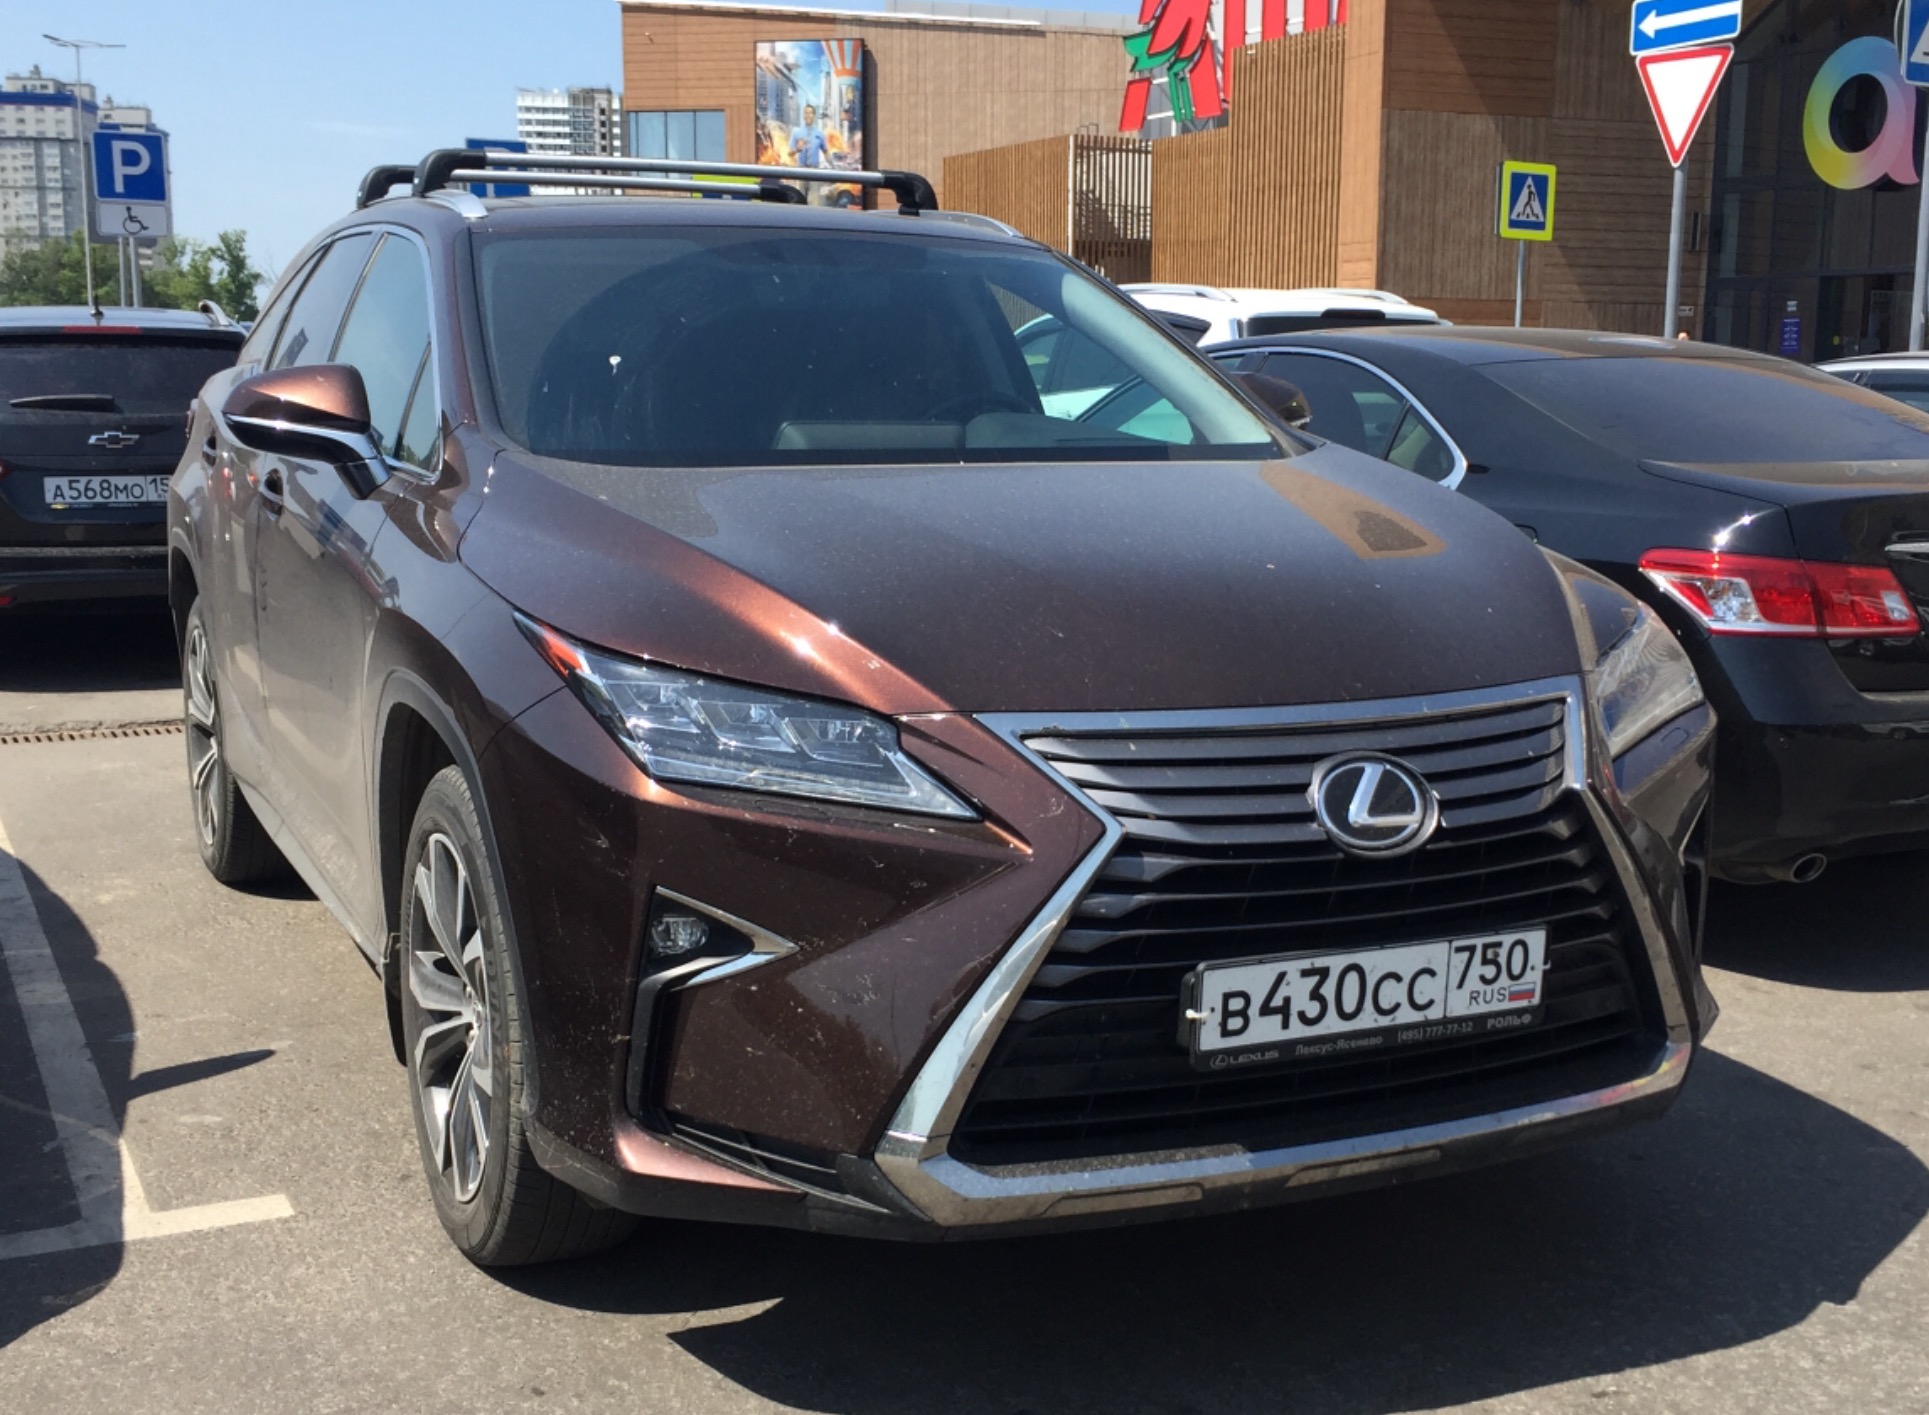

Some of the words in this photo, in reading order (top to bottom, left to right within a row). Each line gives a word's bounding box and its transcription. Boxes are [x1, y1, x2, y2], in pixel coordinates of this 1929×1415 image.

[111, 140, 151, 194] P
[53, 479, 144, 501] А568МО
[1220, 962, 1437, 1039] В430СС
[1454, 938, 1529, 990] 750
[1469, 987, 1507, 1006] RUS
[1487, 1014, 1532, 1030] РОЛЬФ
[1230, 1049, 1280, 1064] LEXUS
